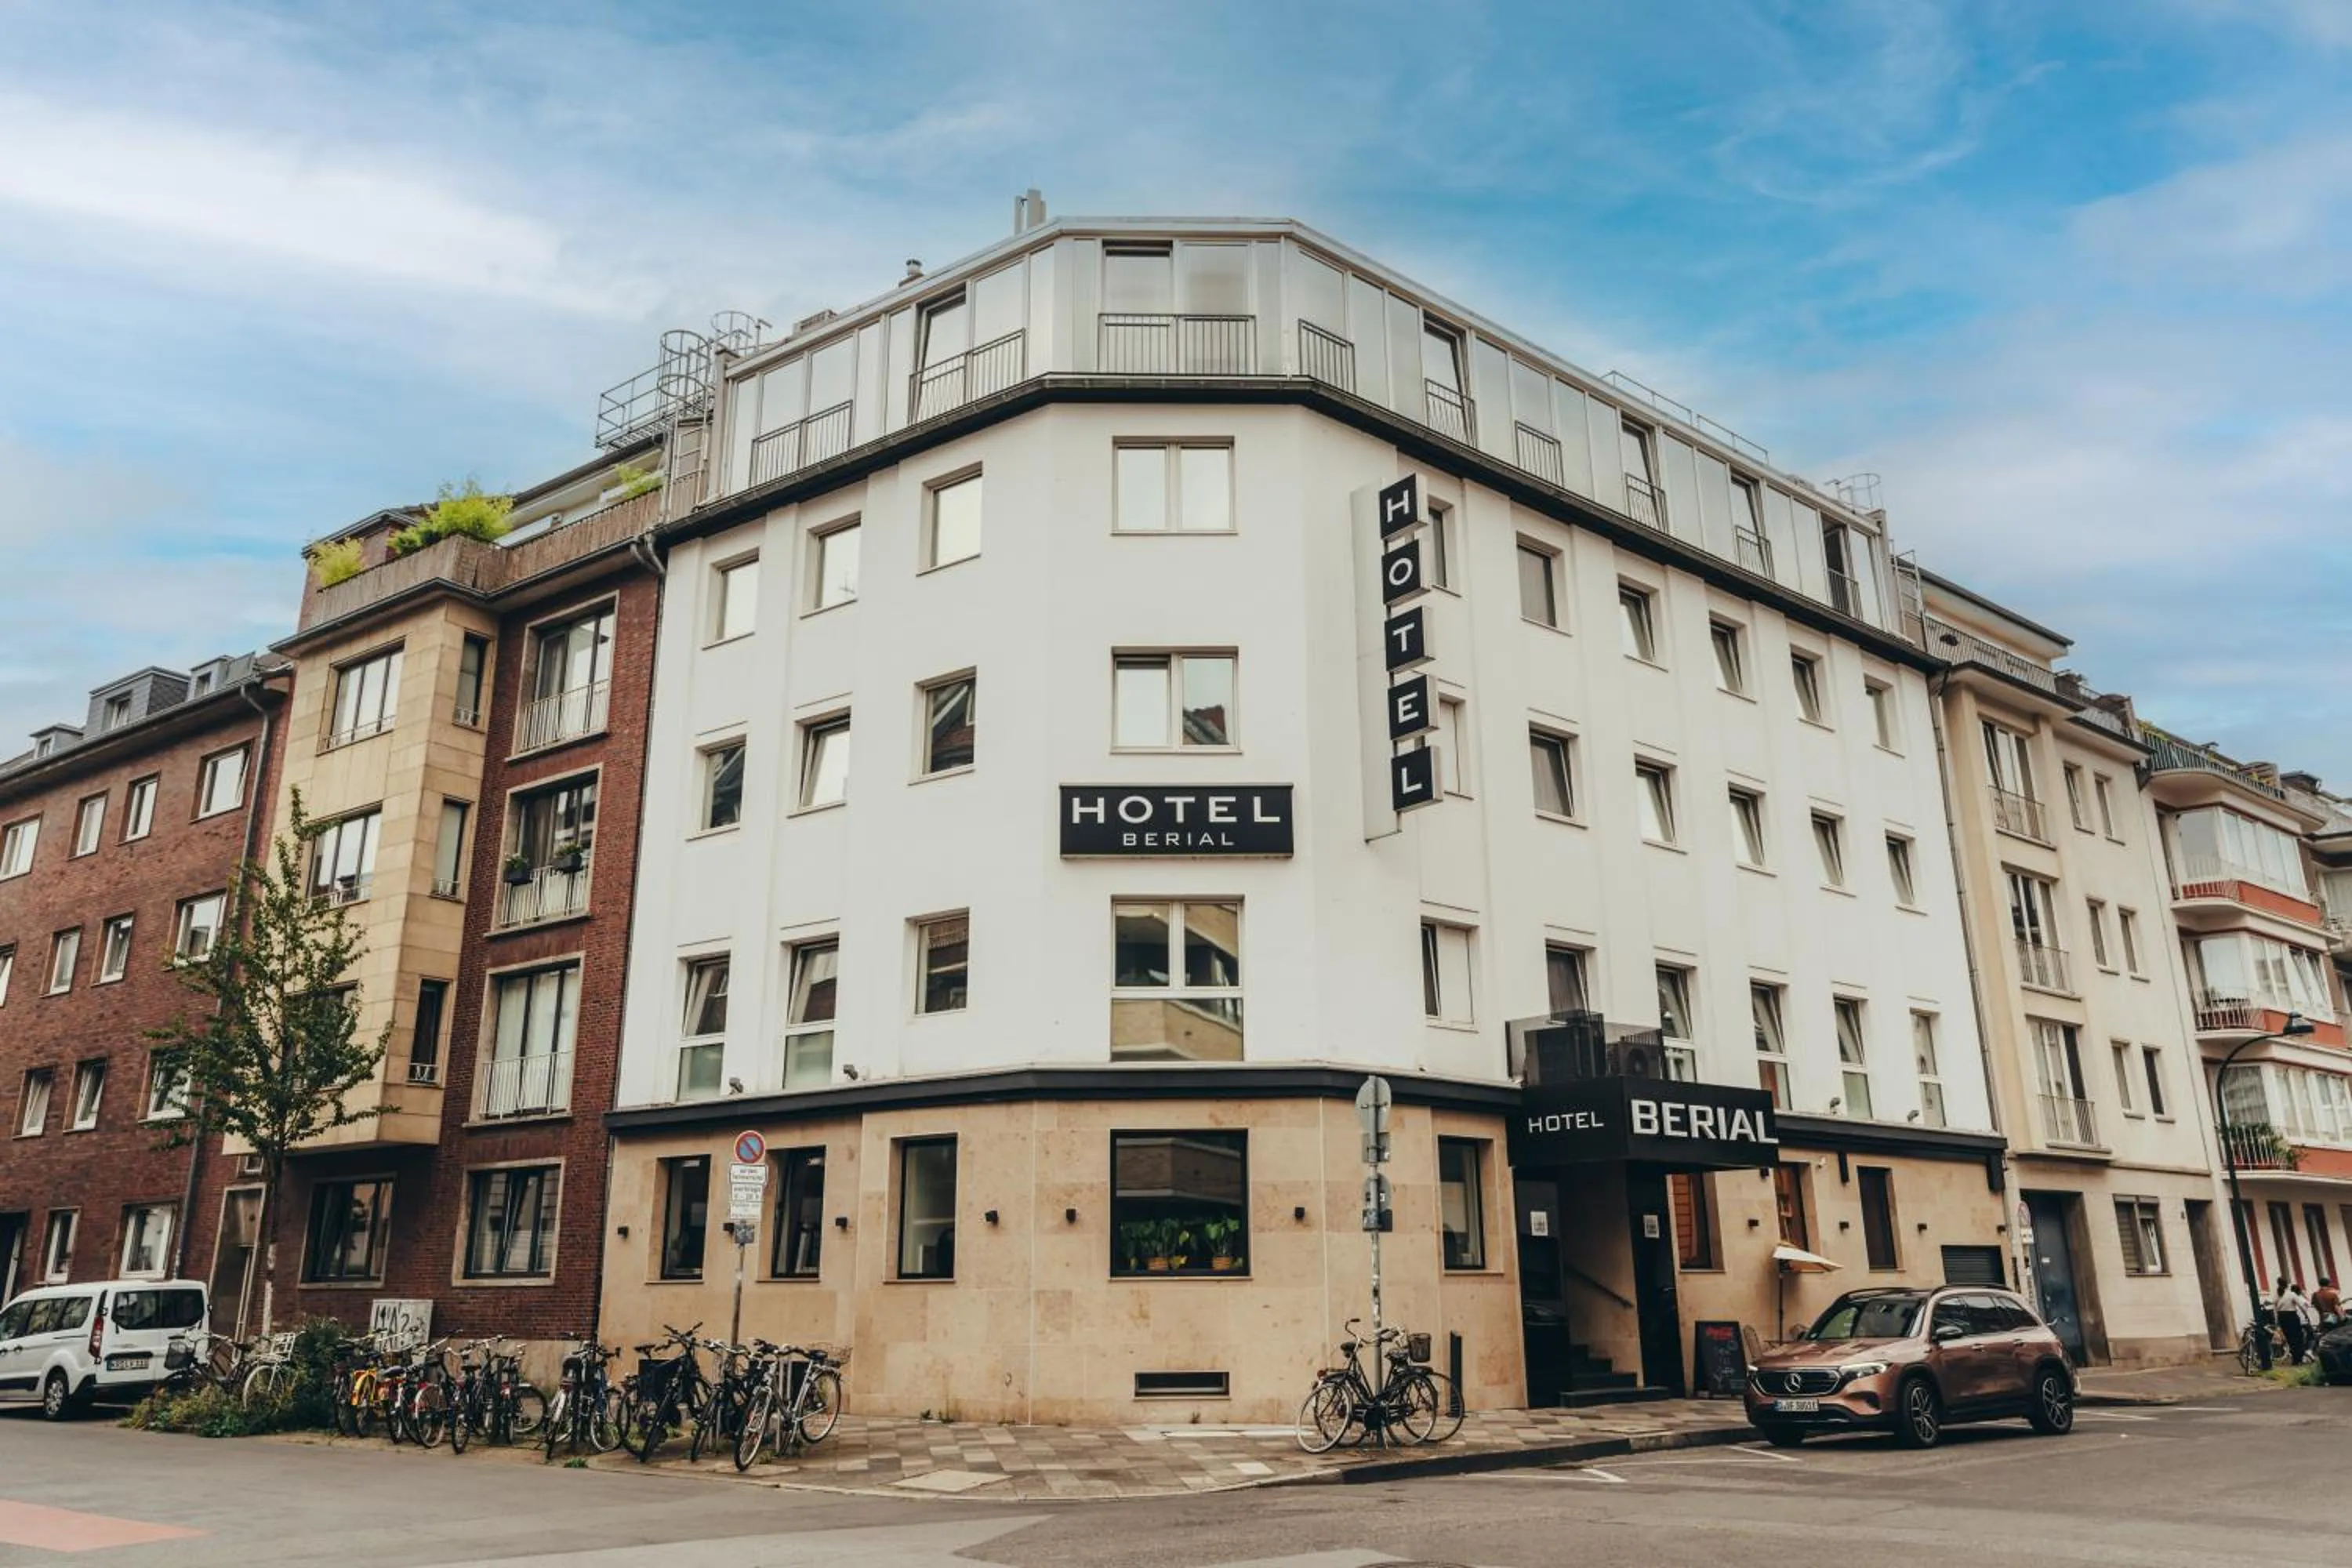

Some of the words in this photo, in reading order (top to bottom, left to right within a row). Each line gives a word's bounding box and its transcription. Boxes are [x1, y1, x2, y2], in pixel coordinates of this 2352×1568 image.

[1386, 488, 1424, 795] HOTEL
[1072, 796, 1280, 823] HOTEL
[1122, 832, 1235, 846] BERIAL
[1529, 1112, 1604, 1133] HOTEL
[1630, 1098, 1780, 1144] BERIAL
